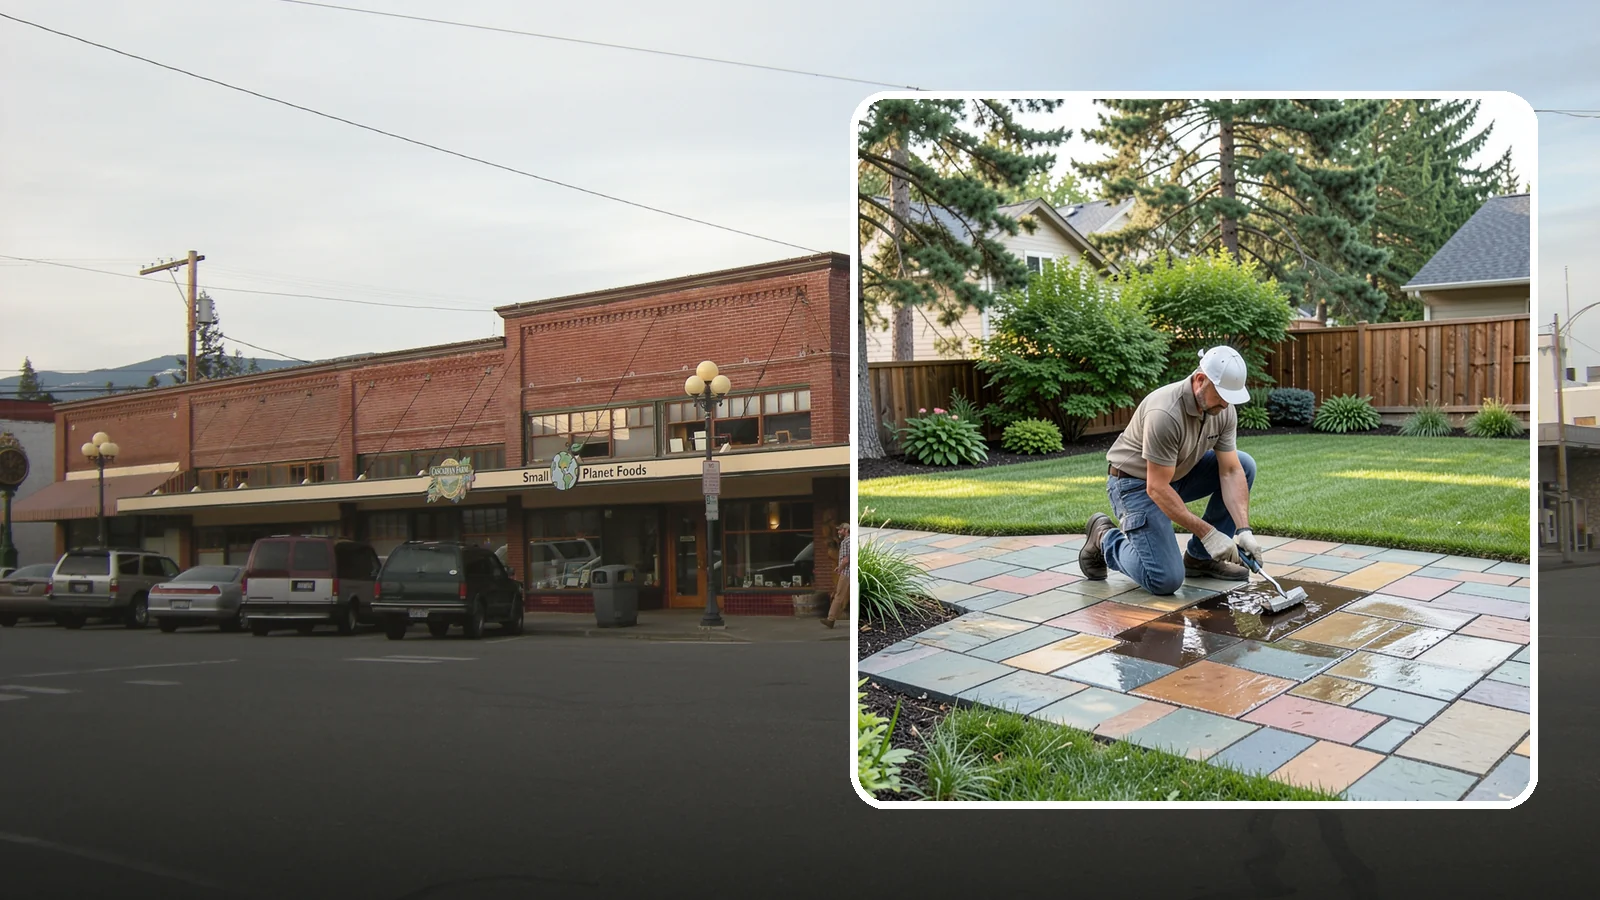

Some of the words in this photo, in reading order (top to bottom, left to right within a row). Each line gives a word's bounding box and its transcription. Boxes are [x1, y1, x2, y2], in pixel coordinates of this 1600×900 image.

[431, 466, 456, 476] CASCADIAN
[523, 471, 549, 483] Small
[583, 467, 614, 479] Planet
[616, 464, 647, 477] Foods
